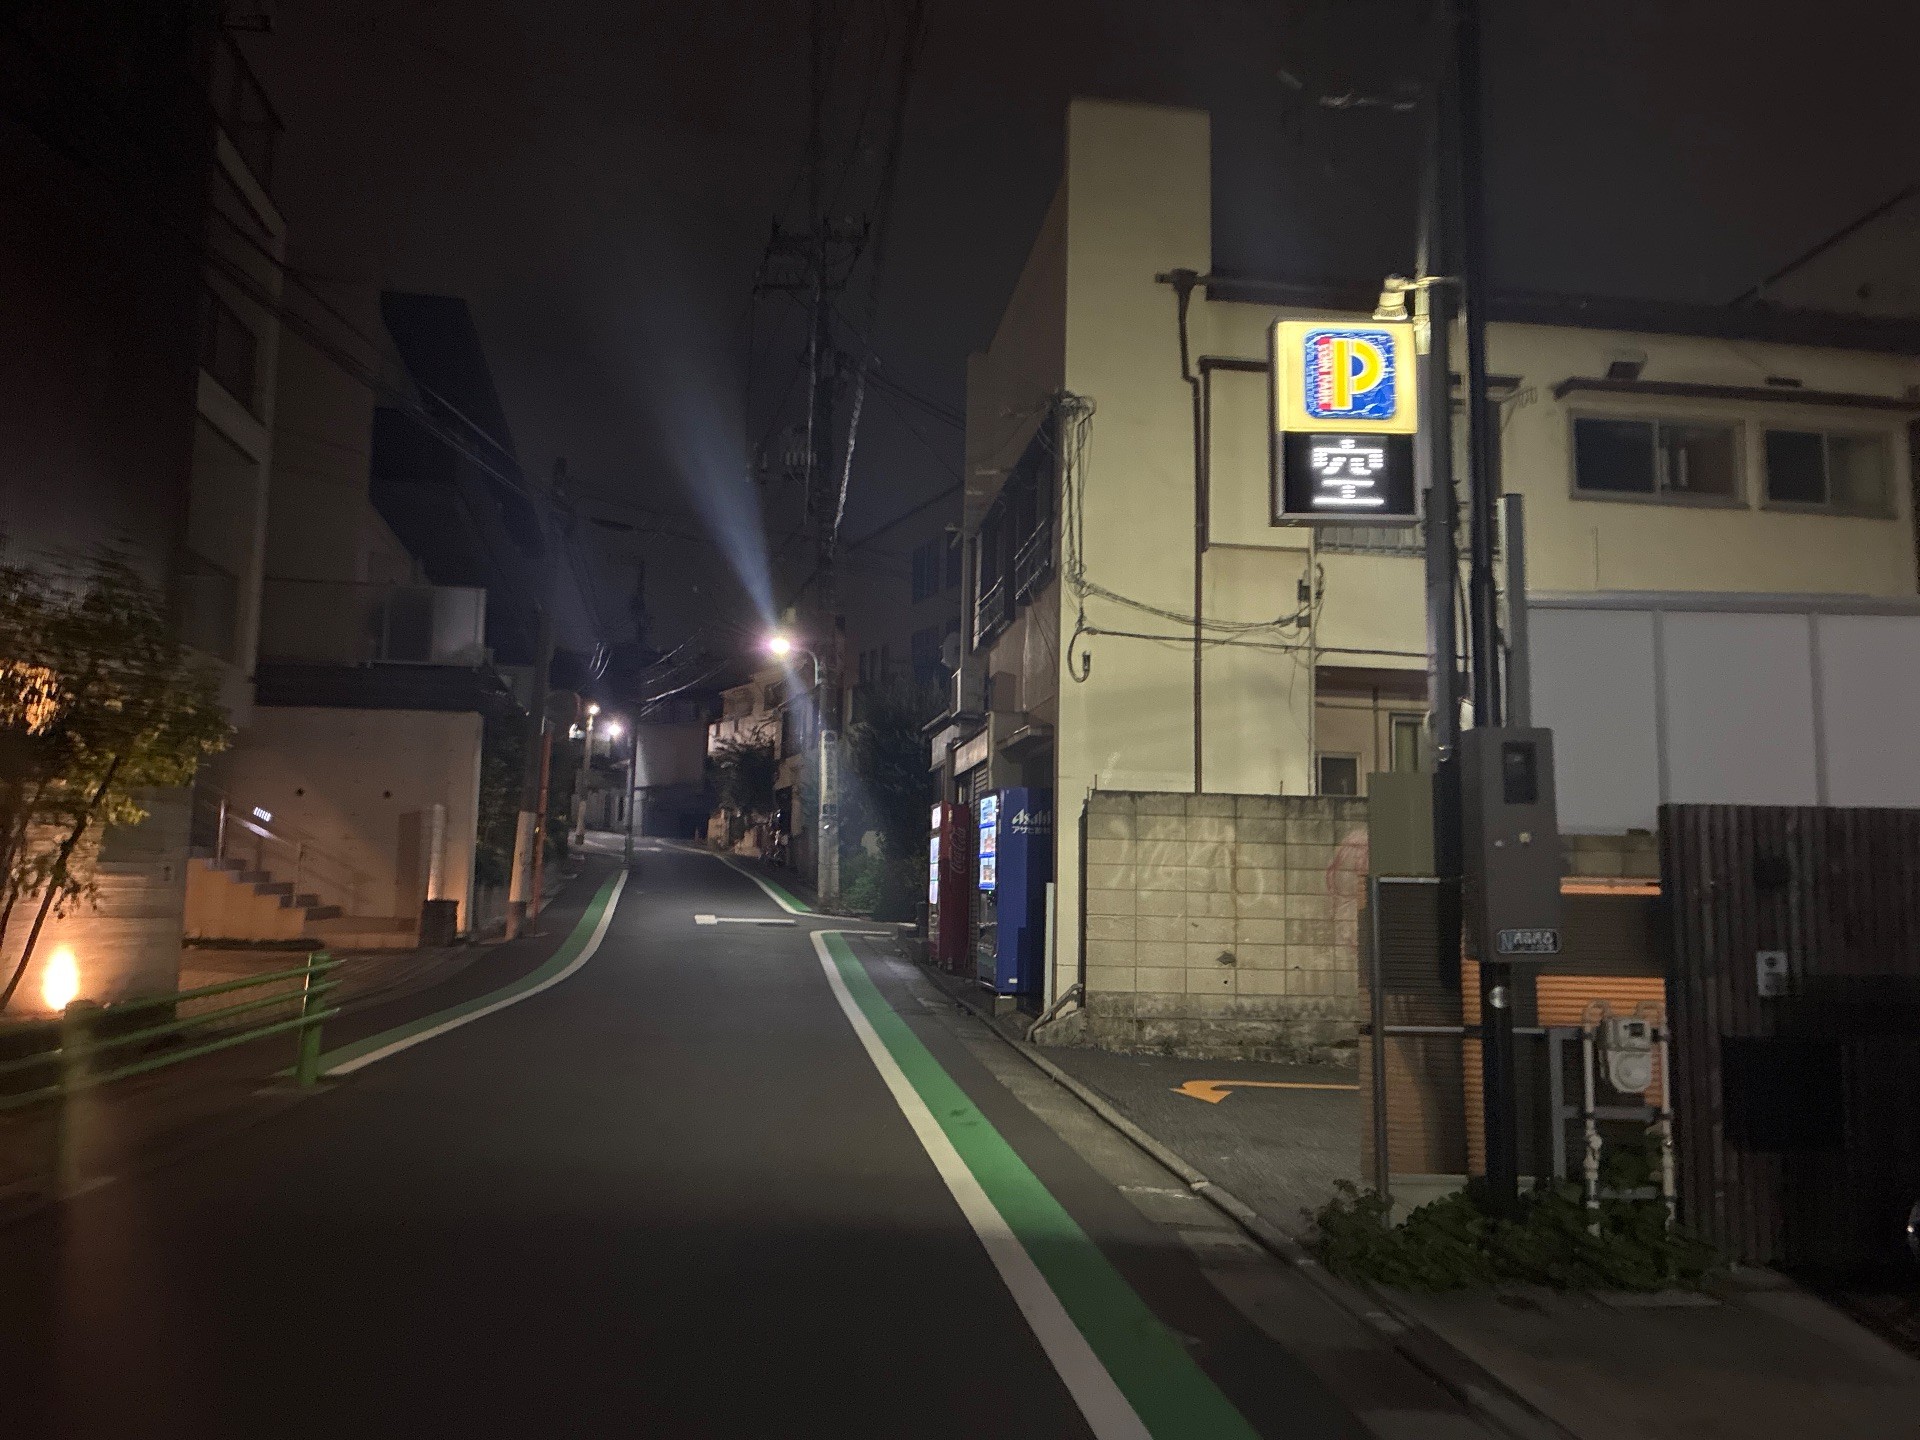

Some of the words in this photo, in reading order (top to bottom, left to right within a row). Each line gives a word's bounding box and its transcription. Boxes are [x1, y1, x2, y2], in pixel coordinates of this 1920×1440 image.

[1331, 338, 1386, 410] P
[1312, 439, 1384, 504] 空
[1011, 808, 1051, 825] Asahi
